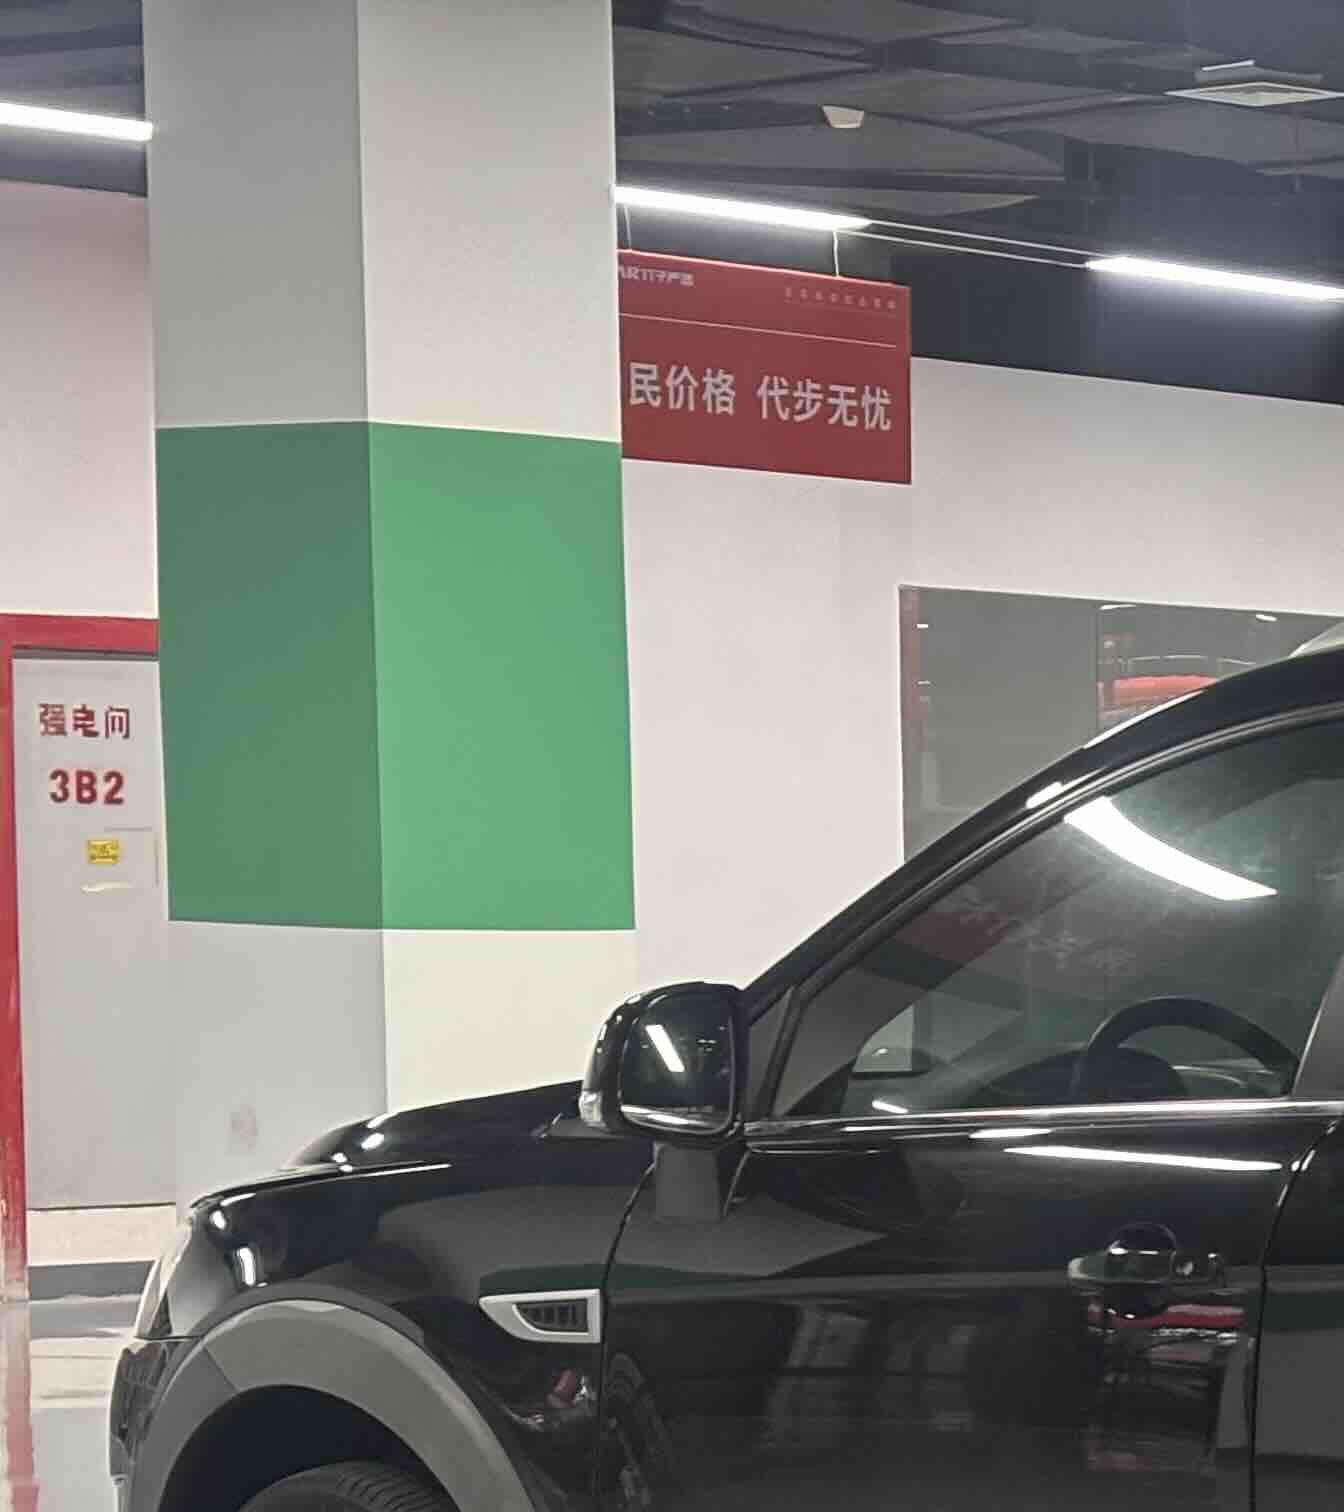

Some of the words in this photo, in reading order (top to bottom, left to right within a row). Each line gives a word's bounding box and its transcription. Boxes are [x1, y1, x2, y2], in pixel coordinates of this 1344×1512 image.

[628, 361, 736, 416] 民价格
[756, 375, 893, 432] 代步无忧
[37, 703, 131, 739] 强电间
[49, 768, 125, 805] 3B2
